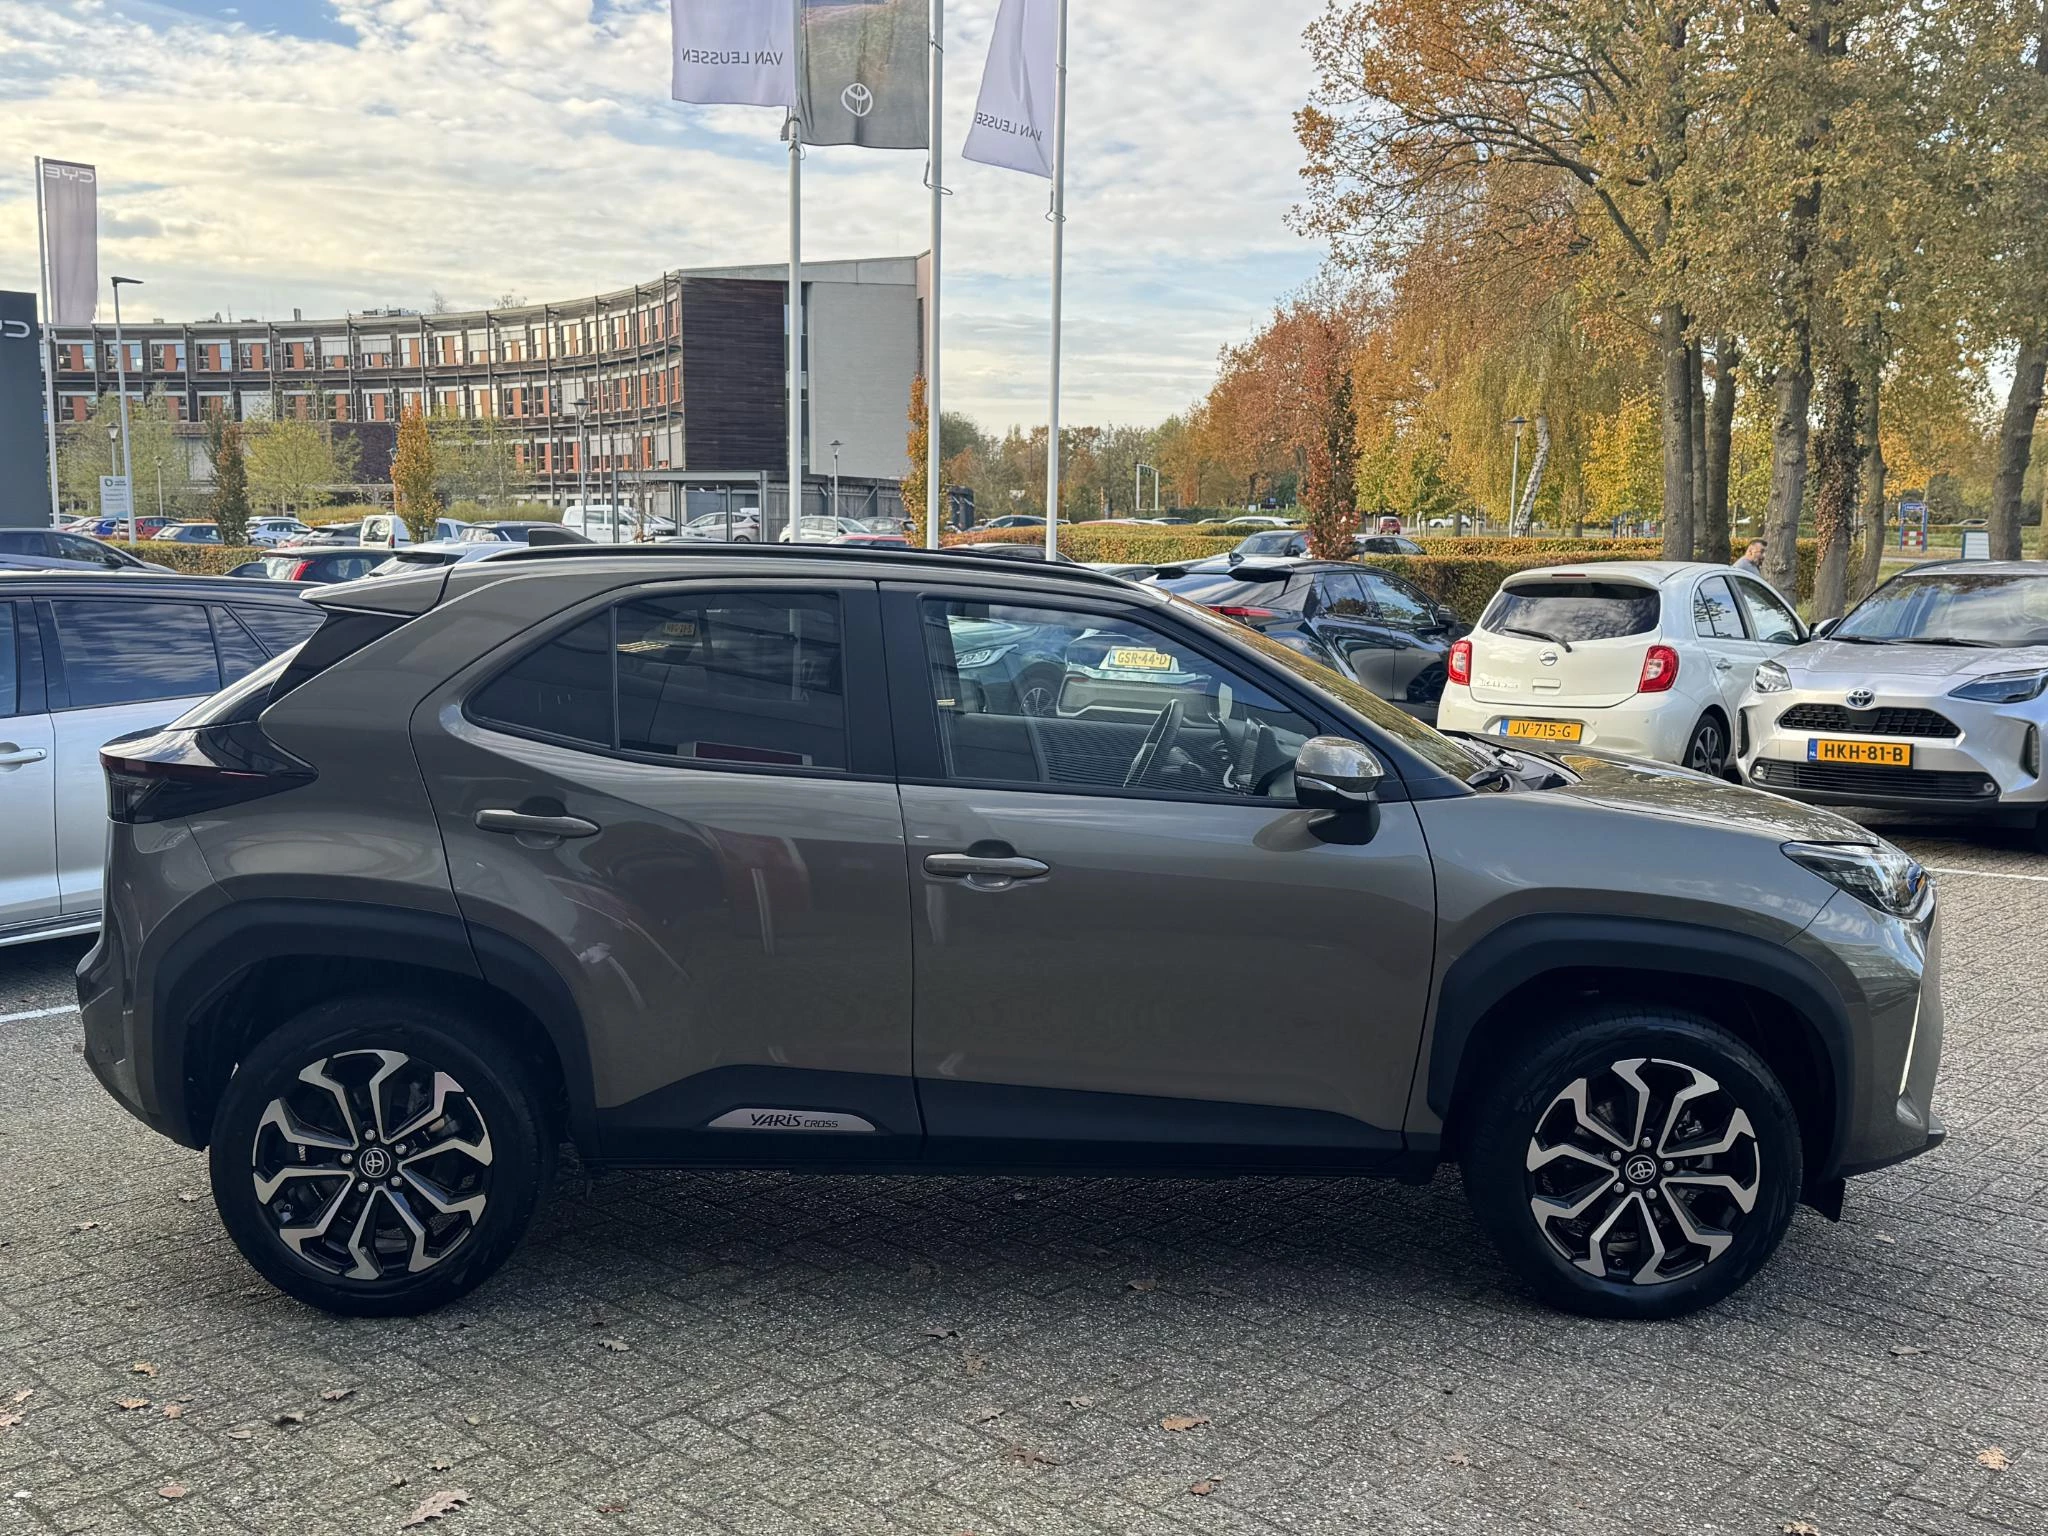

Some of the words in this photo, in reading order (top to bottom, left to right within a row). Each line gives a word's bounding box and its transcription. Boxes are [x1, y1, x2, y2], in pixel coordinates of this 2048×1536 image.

[44, 166, 94, 183] BYD
[1117, 652, 1167, 665] GSR-44-D
[1513, 722, 1571, 738] JV-715-G
[1824, 743, 1903, 762] HKH-81-B
[804, 1119, 838, 1128] CROSS
